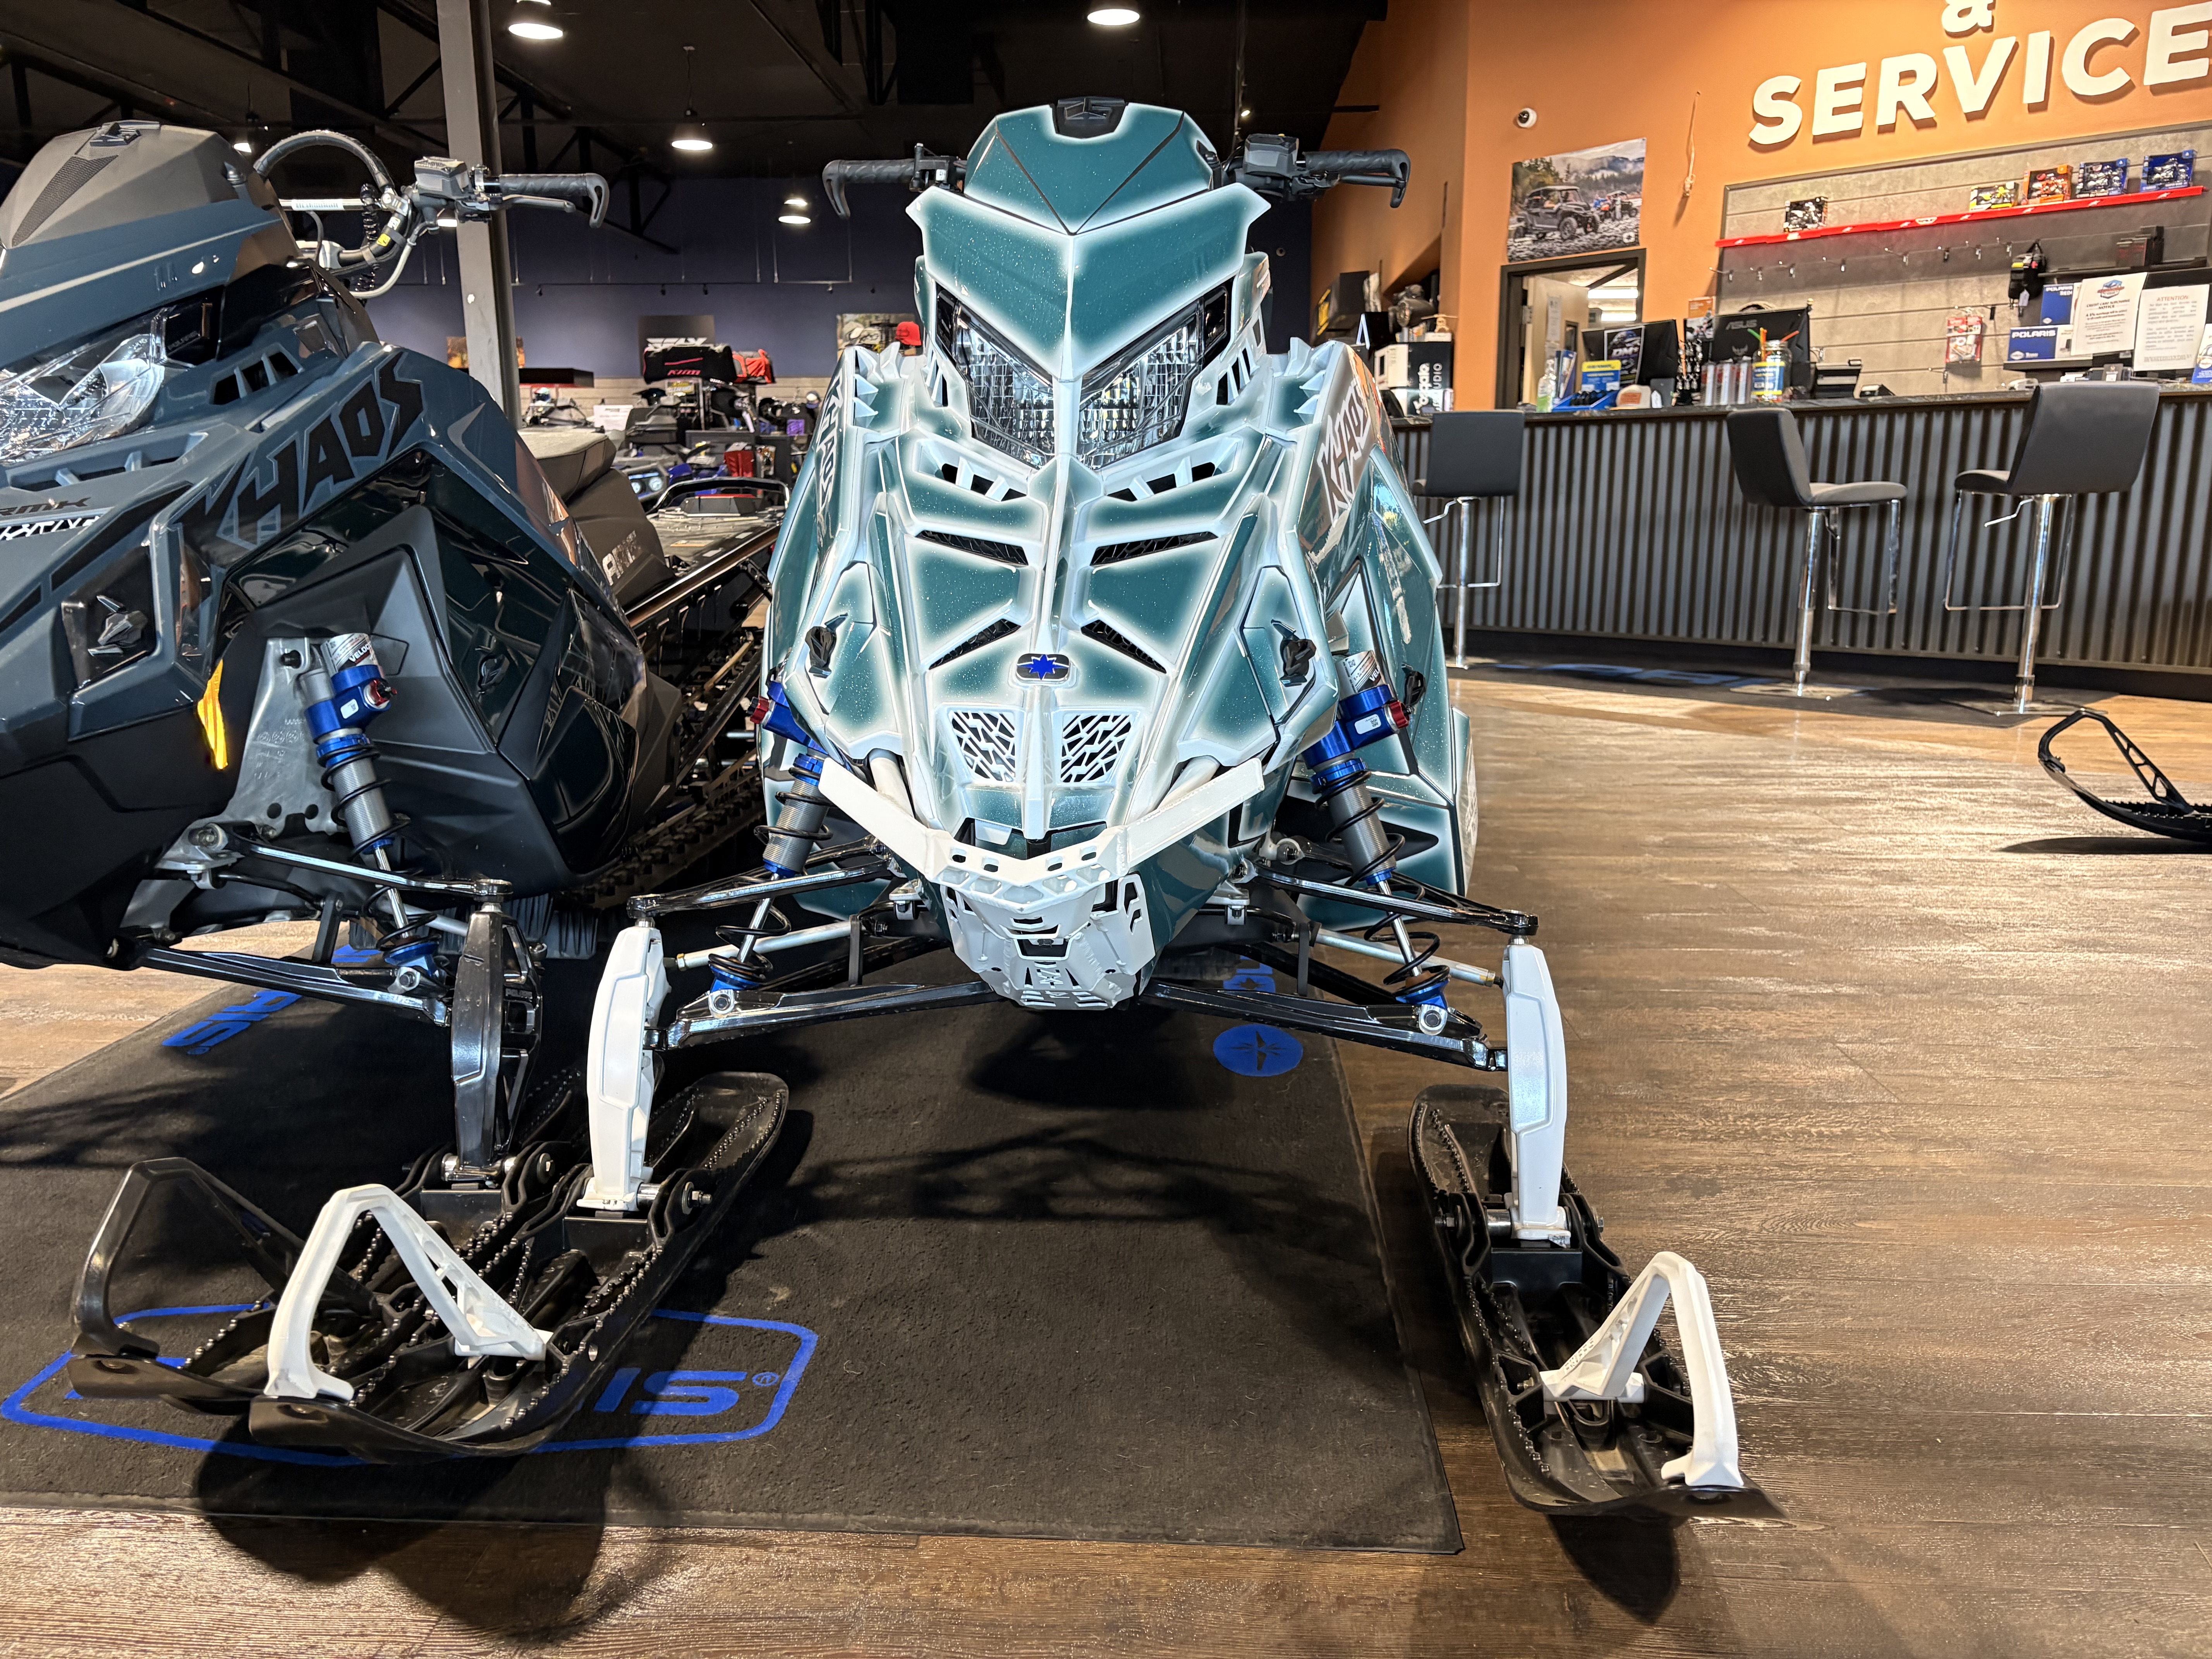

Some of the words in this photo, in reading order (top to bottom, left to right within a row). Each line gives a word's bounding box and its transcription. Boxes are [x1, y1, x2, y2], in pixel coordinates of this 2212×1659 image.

[1748, 2, 2212, 145] SERVICE
[2012, 330, 2056, 338] POLARIS
[1433, 363, 1443, 395] UDIO
[177, 350, 424, 565] KHAOS
